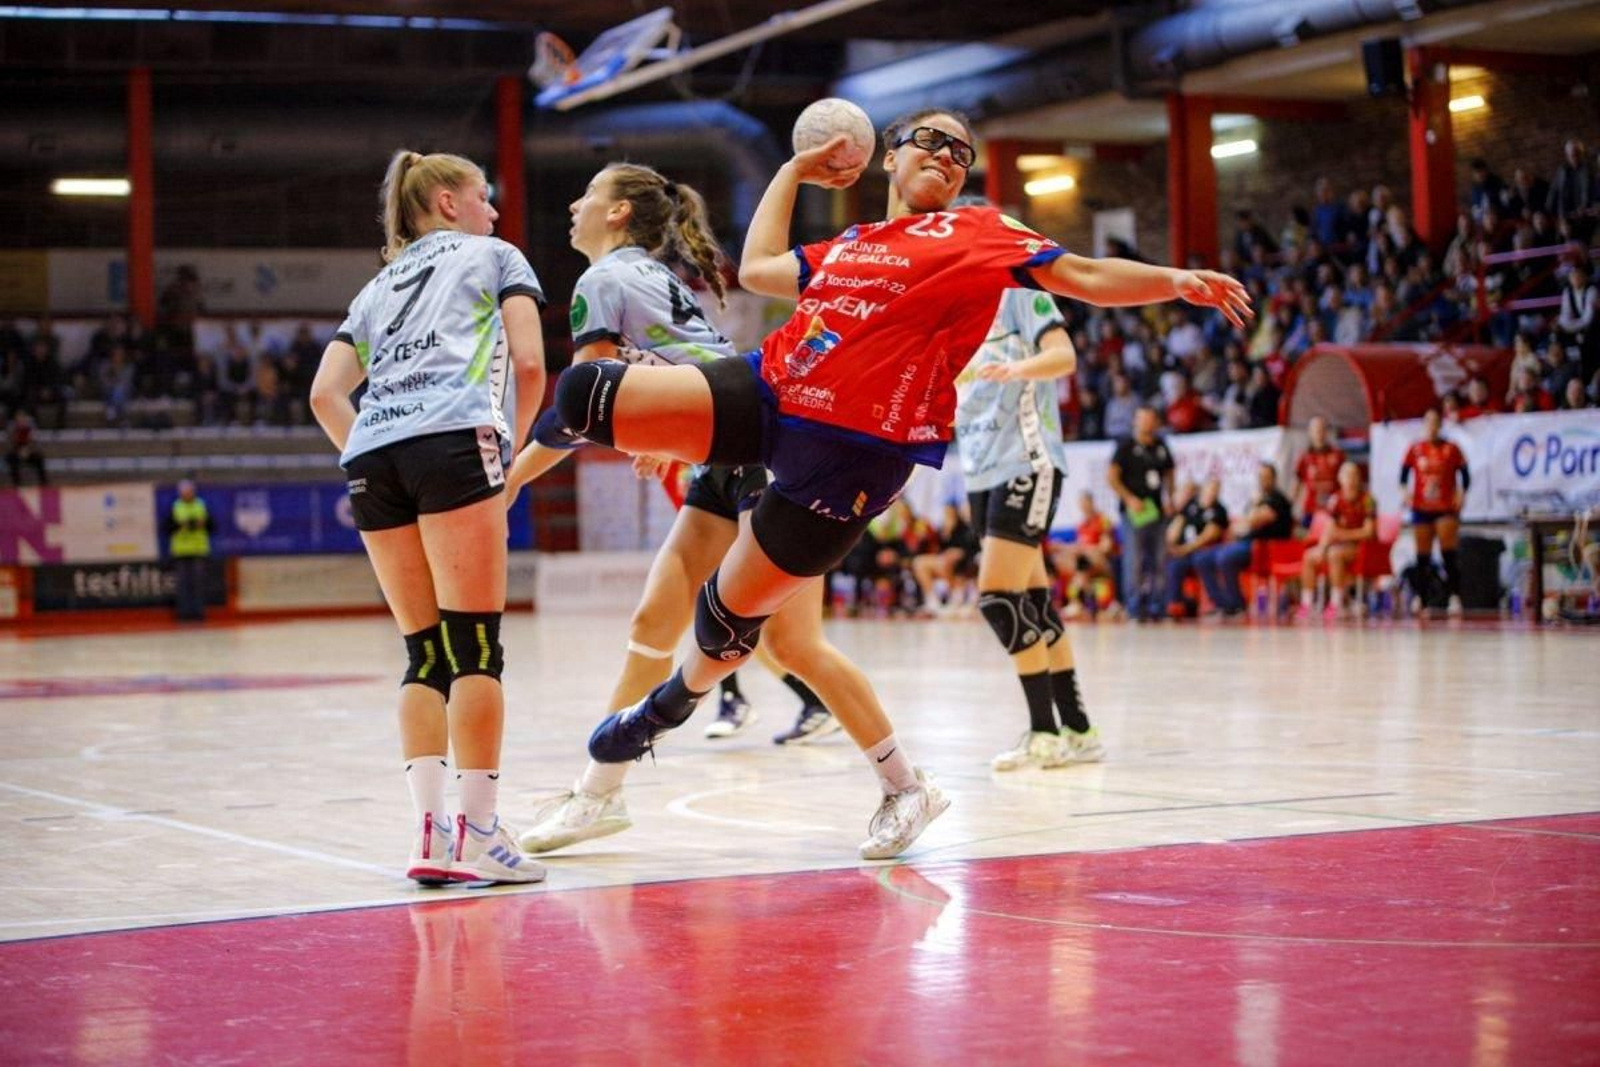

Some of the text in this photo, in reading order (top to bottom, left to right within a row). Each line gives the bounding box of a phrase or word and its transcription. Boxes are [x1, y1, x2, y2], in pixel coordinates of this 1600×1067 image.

[905, 212, 960, 239] 23
[838, 251, 911, 268] DE GALICIA
[845, 240, 888, 253] XUNTA
[391, 265, 436, 336] 7
[881, 363, 918, 433] PipeWorks
